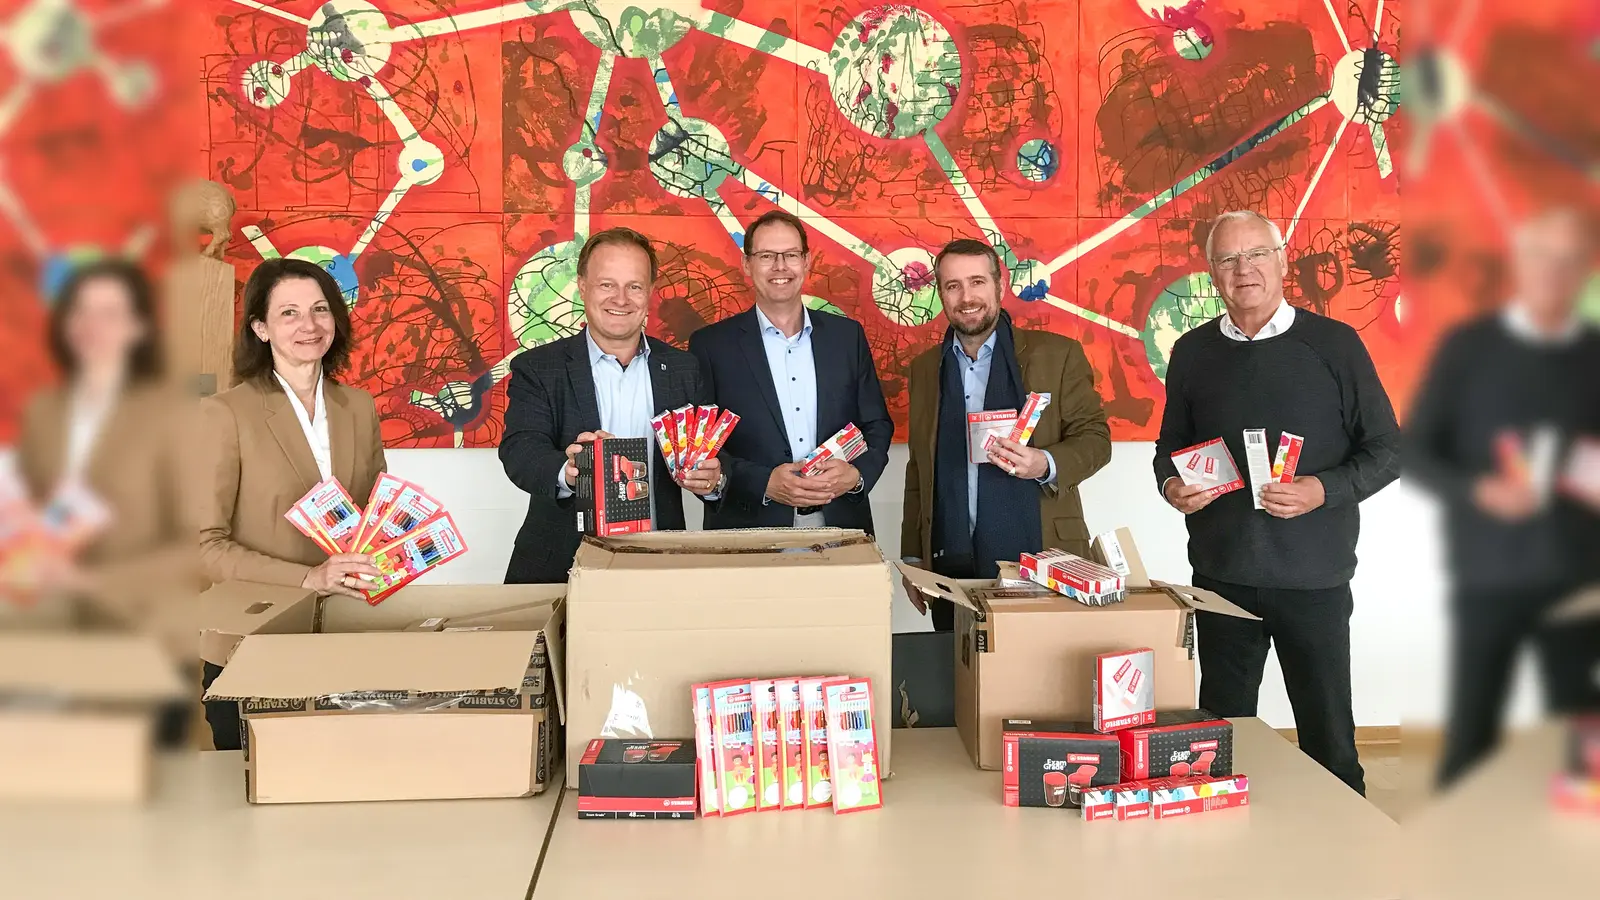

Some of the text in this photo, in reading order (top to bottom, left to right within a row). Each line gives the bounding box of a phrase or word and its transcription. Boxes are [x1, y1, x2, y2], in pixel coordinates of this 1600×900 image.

[246, 700, 289, 710] STABILO
[463, 696, 505, 705] STABILO
[1104, 717, 1131, 729] STABILO
[1046, 758, 1066, 766] Exam
